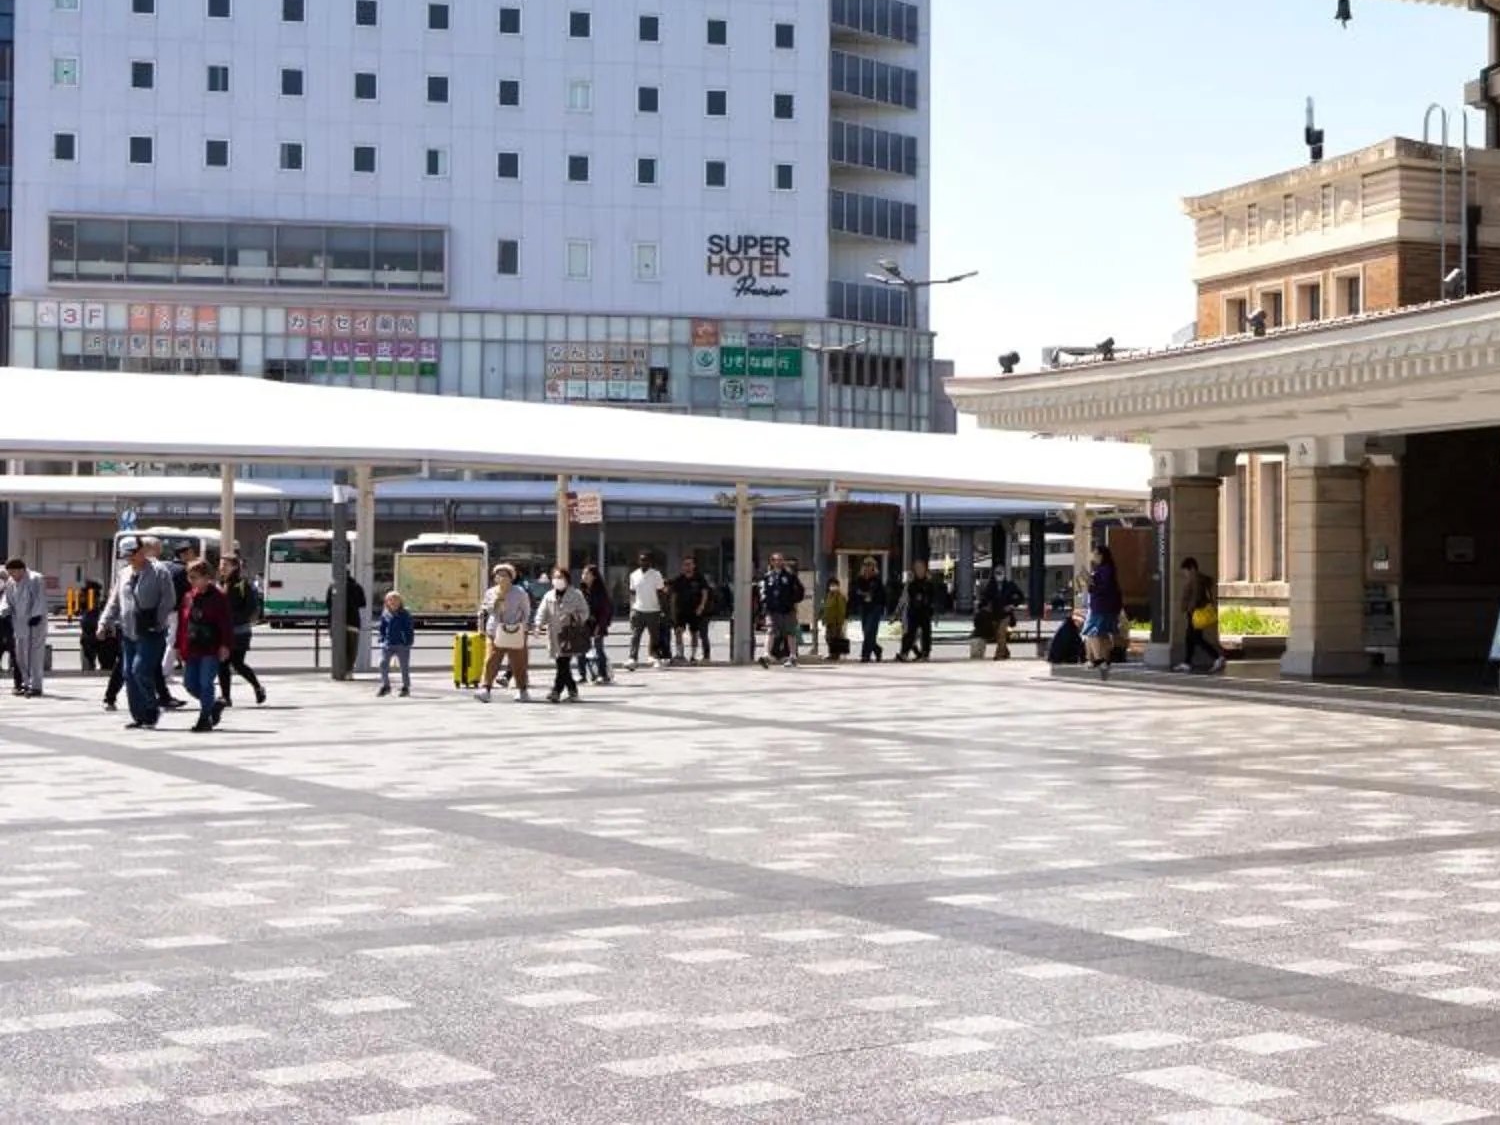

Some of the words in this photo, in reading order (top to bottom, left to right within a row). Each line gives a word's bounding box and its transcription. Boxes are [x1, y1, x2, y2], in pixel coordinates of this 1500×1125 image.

[707, 234, 790, 257] SUPER
[707, 256, 790, 277] HOTEL
[732, 275, 789, 297] Premier
